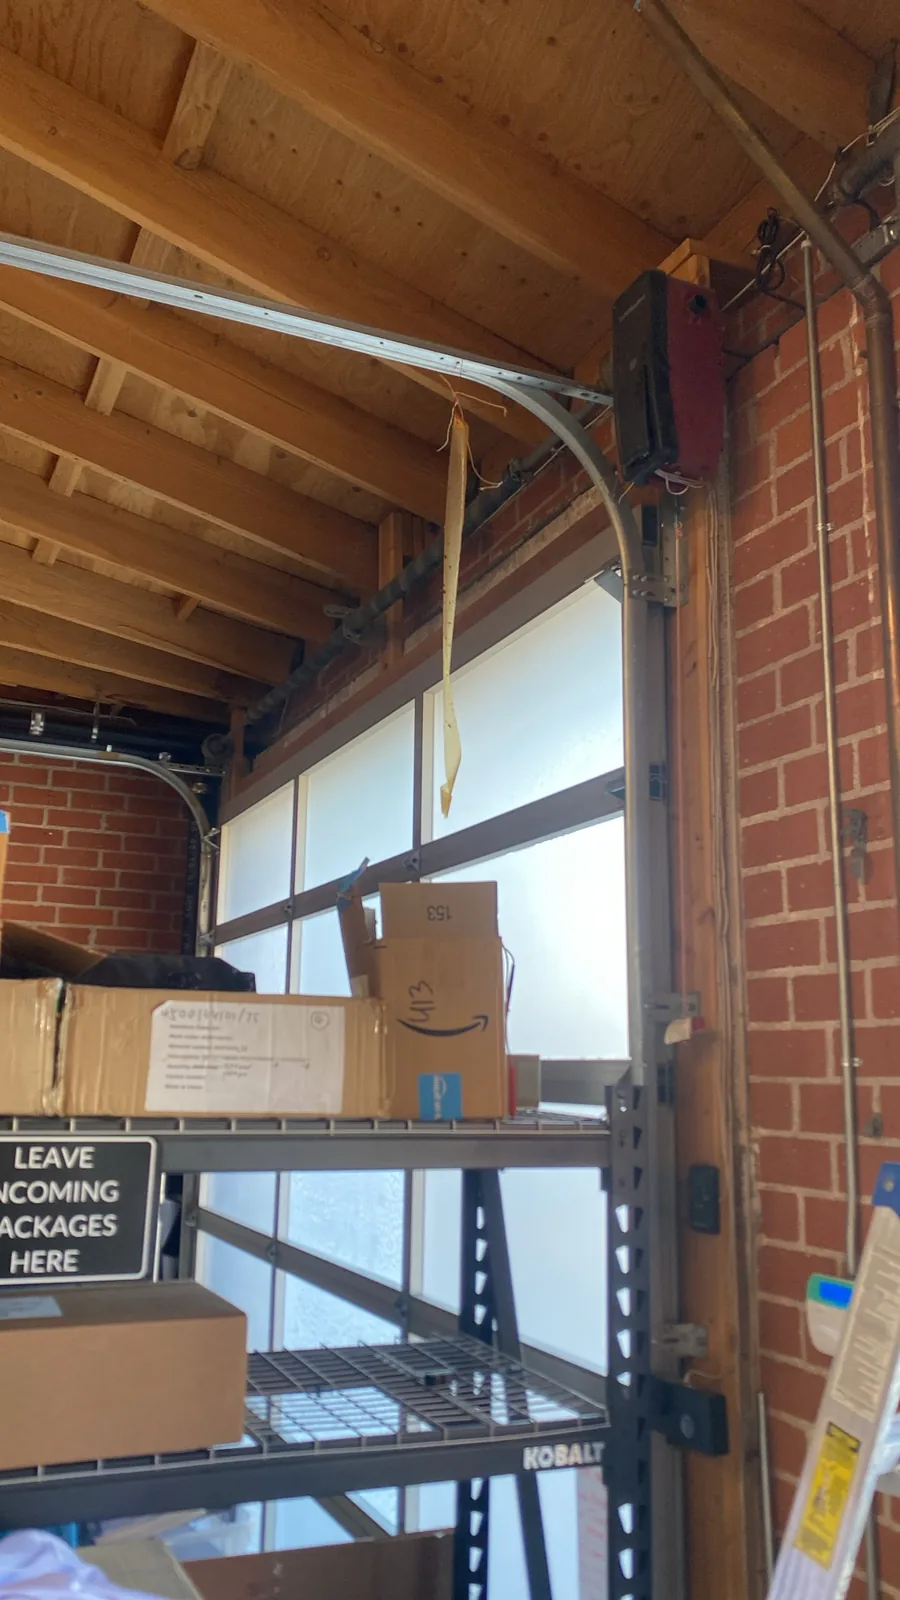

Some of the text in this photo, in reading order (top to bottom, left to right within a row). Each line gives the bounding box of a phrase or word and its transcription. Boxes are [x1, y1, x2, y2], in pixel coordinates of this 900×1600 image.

[427, 905, 452, 921] 153
[14, 1146, 96, 1170] LEAVE
[0, 1180, 120, 1204] NCOMING
[0, 1214, 118, 1239] ACKAGES
[10, 1249, 81, 1274] HERE
[523, 1441, 606, 1470] KOBALT
